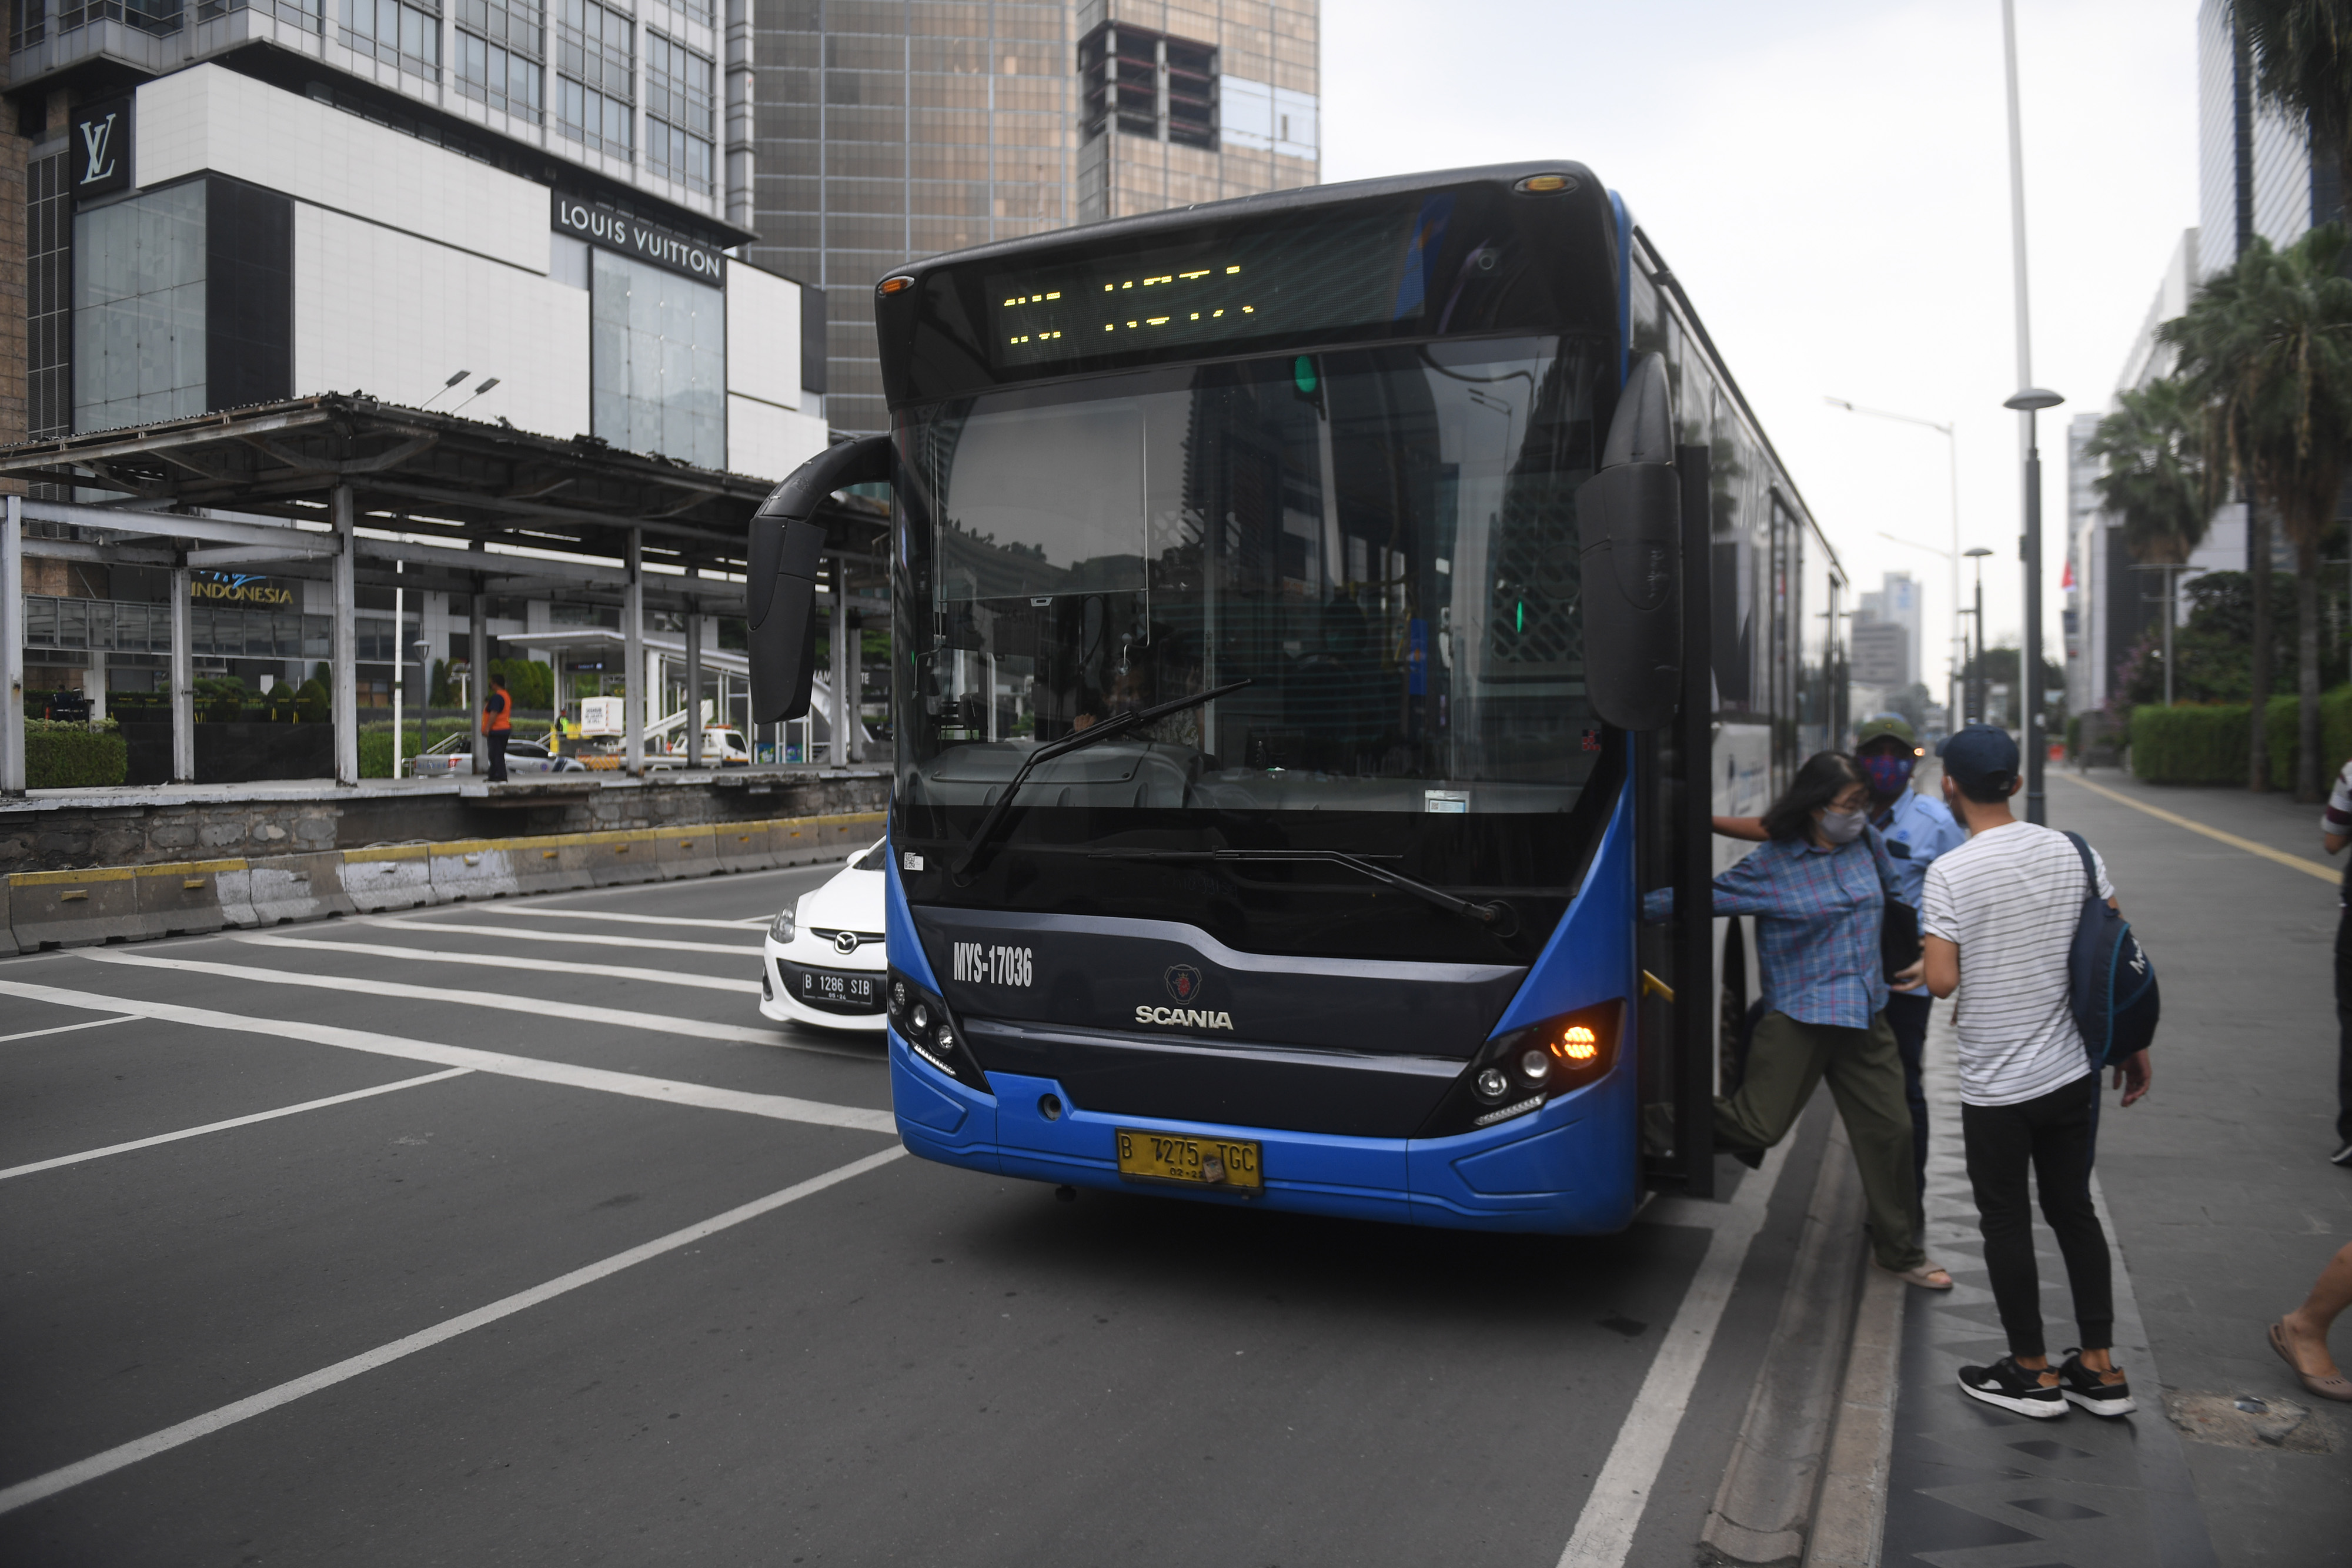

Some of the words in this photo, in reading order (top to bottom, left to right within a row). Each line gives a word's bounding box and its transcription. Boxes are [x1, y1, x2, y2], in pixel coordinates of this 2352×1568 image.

[561, 200, 626, 244] LOUIS
[633, 227, 720, 279] VUITTON
[191, 581, 293, 604] INDONESIA
[953, 942, 1033, 987] MYS-17036
[805, 974, 812, 989] B
[820, 975, 844, 992] 1286
[850, 979, 870, 995] SIB
[1135, 1005, 1234, 1030] SCANIA
[1120, 1134, 1132, 1159] B
[1150, 1138, 1199, 1166] 7275
[1217, 1144, 1254, 1171] TGC
